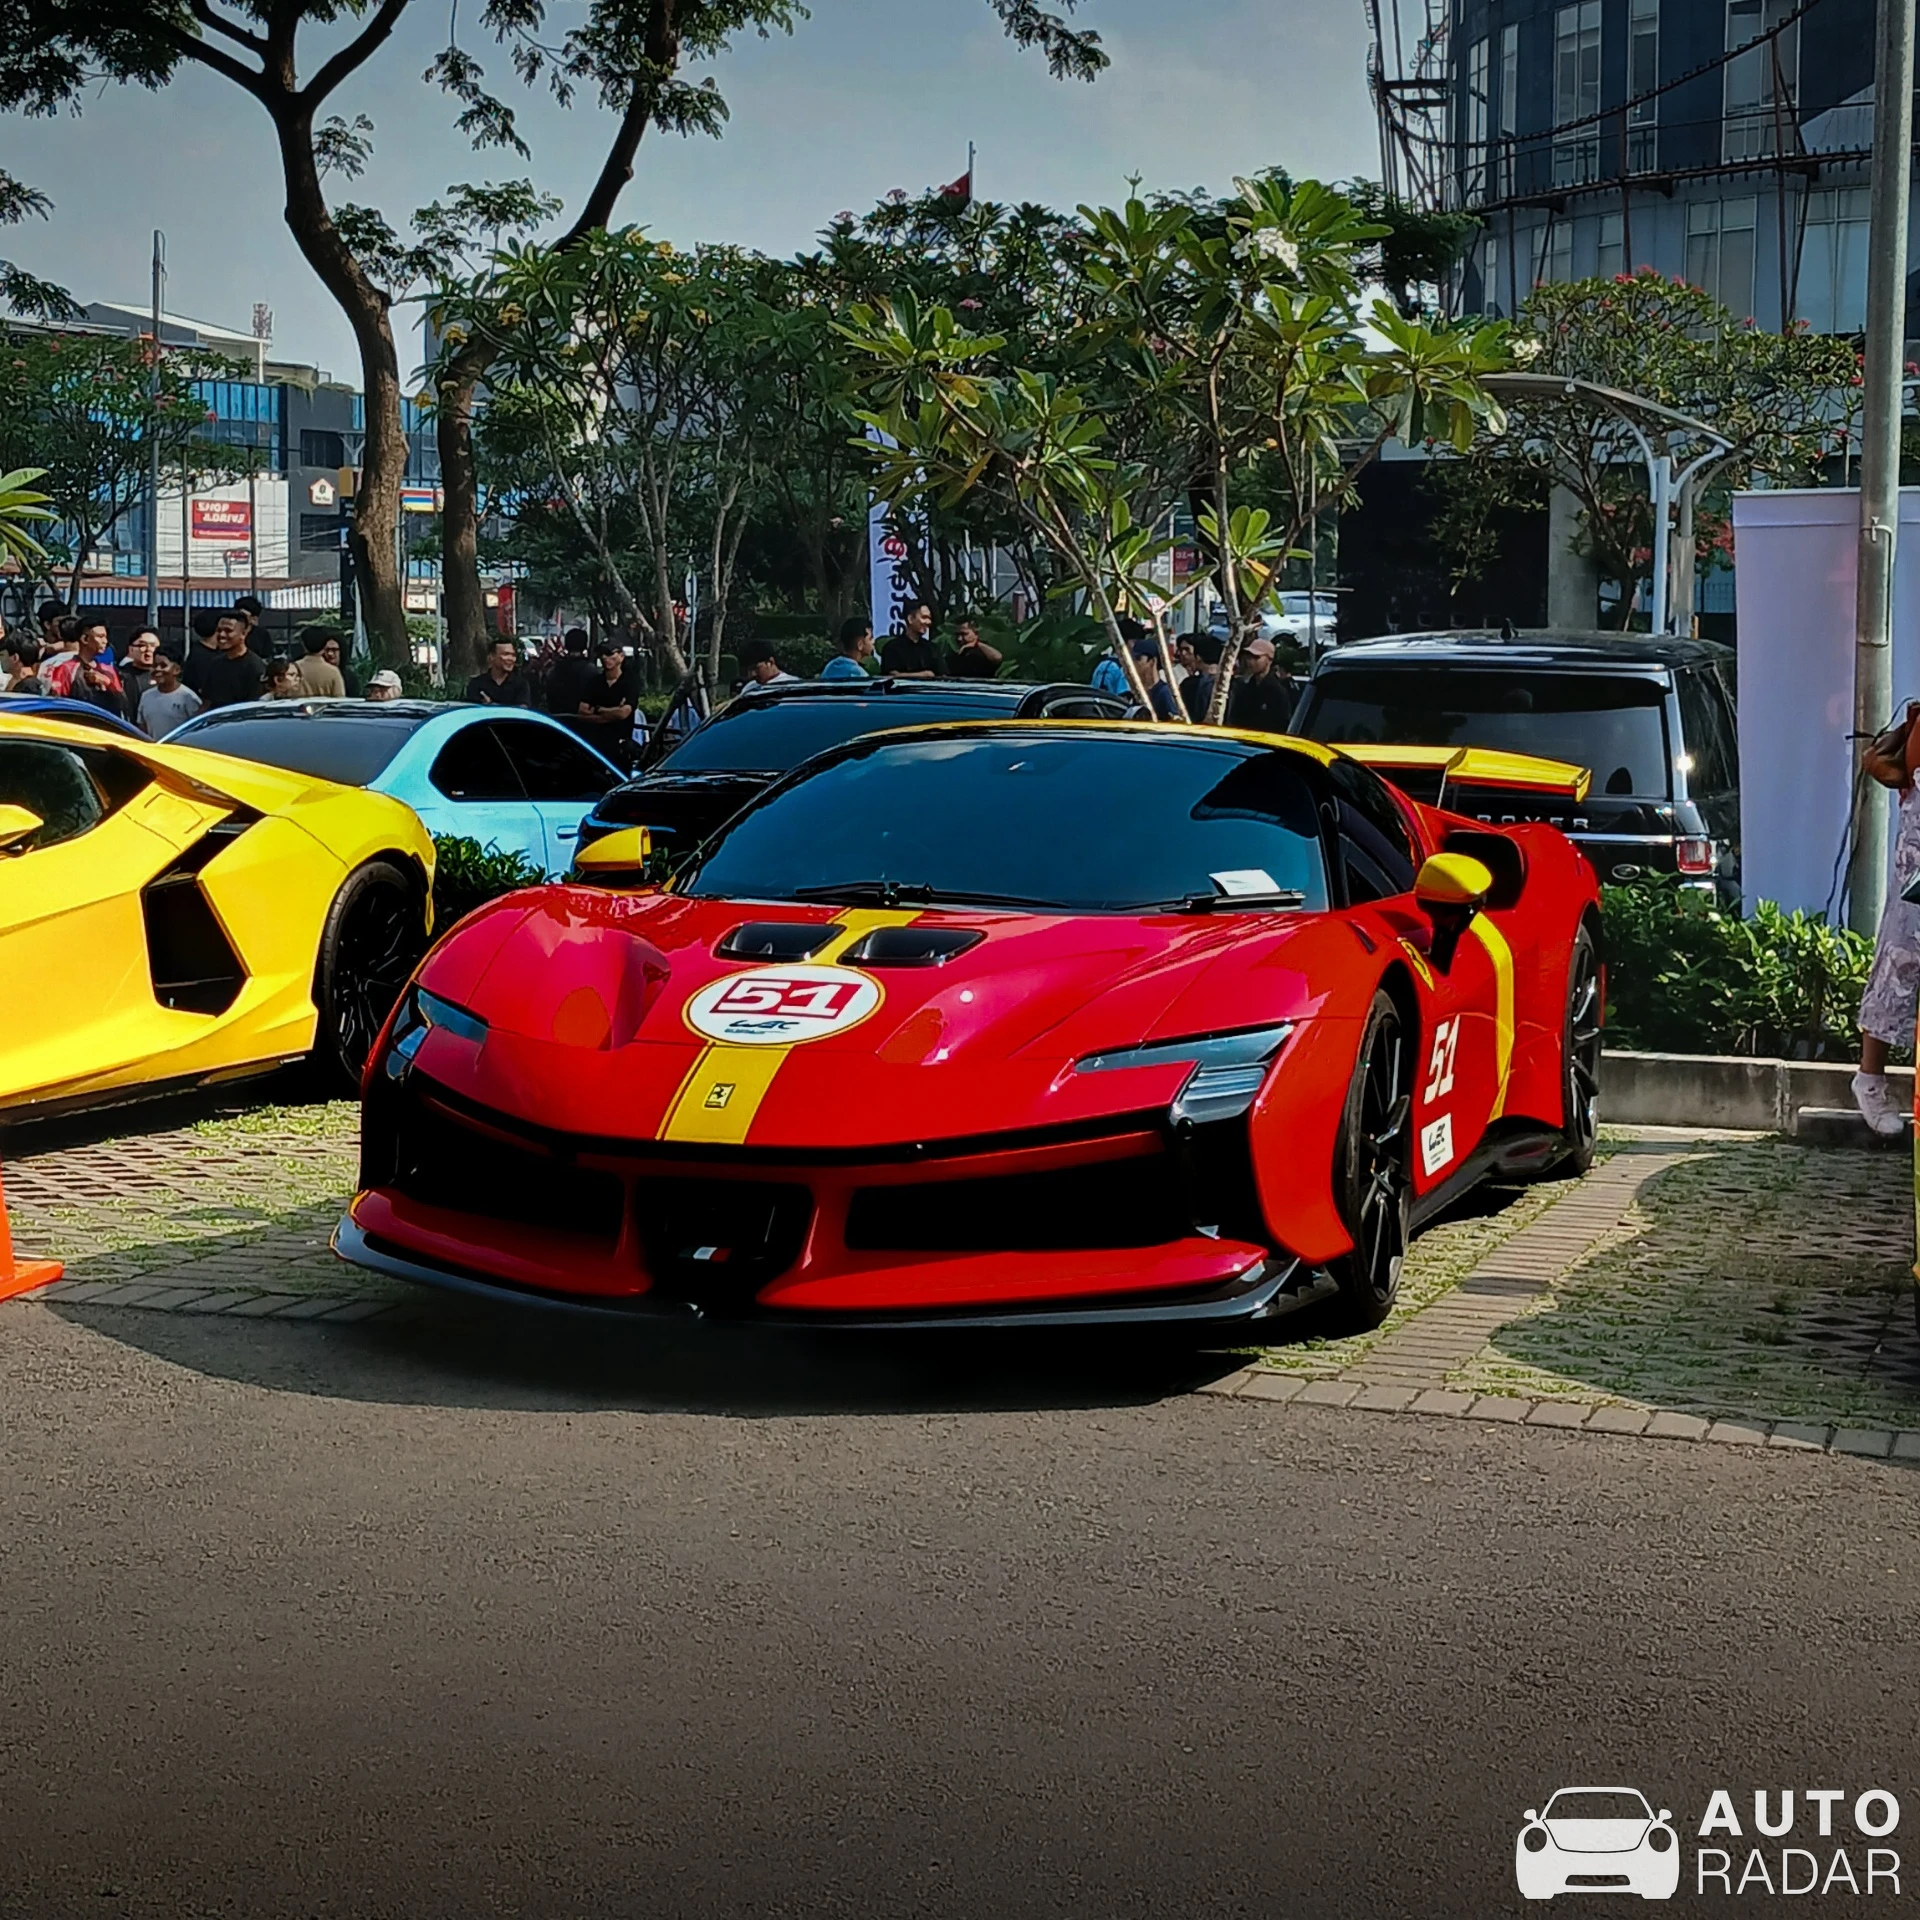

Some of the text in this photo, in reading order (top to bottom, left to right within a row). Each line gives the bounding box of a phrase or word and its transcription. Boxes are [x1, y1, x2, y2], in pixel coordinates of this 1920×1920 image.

[198, 501, 230, 513] SHOP
[717, 981, 843, 1016] 51
[1424, 1014, 1460, 1105] 51
